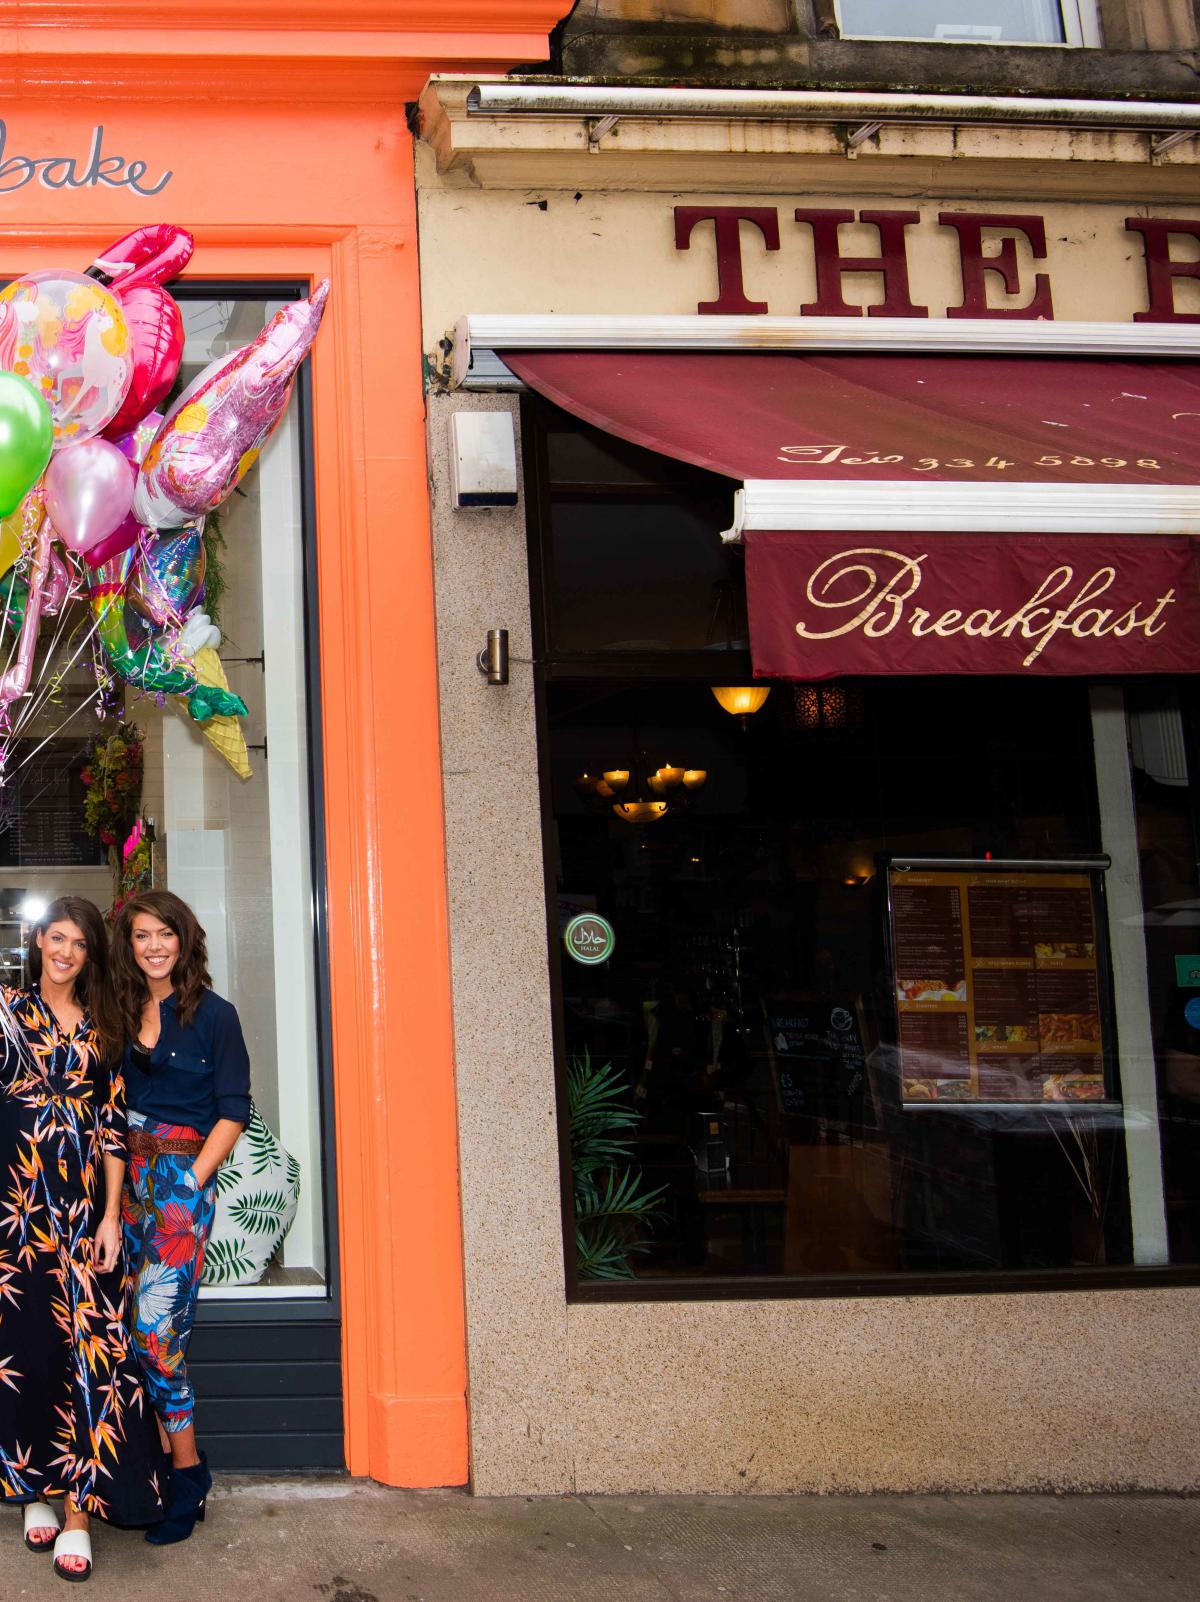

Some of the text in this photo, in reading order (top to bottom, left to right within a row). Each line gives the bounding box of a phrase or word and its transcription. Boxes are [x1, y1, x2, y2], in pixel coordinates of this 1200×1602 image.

[675, 205, 1053, 320] THE
[1033, 454, 1161, 471] 5898
[794, 547, 1177, 668] Breakfast
[574, 927, 606, 944] حلال
